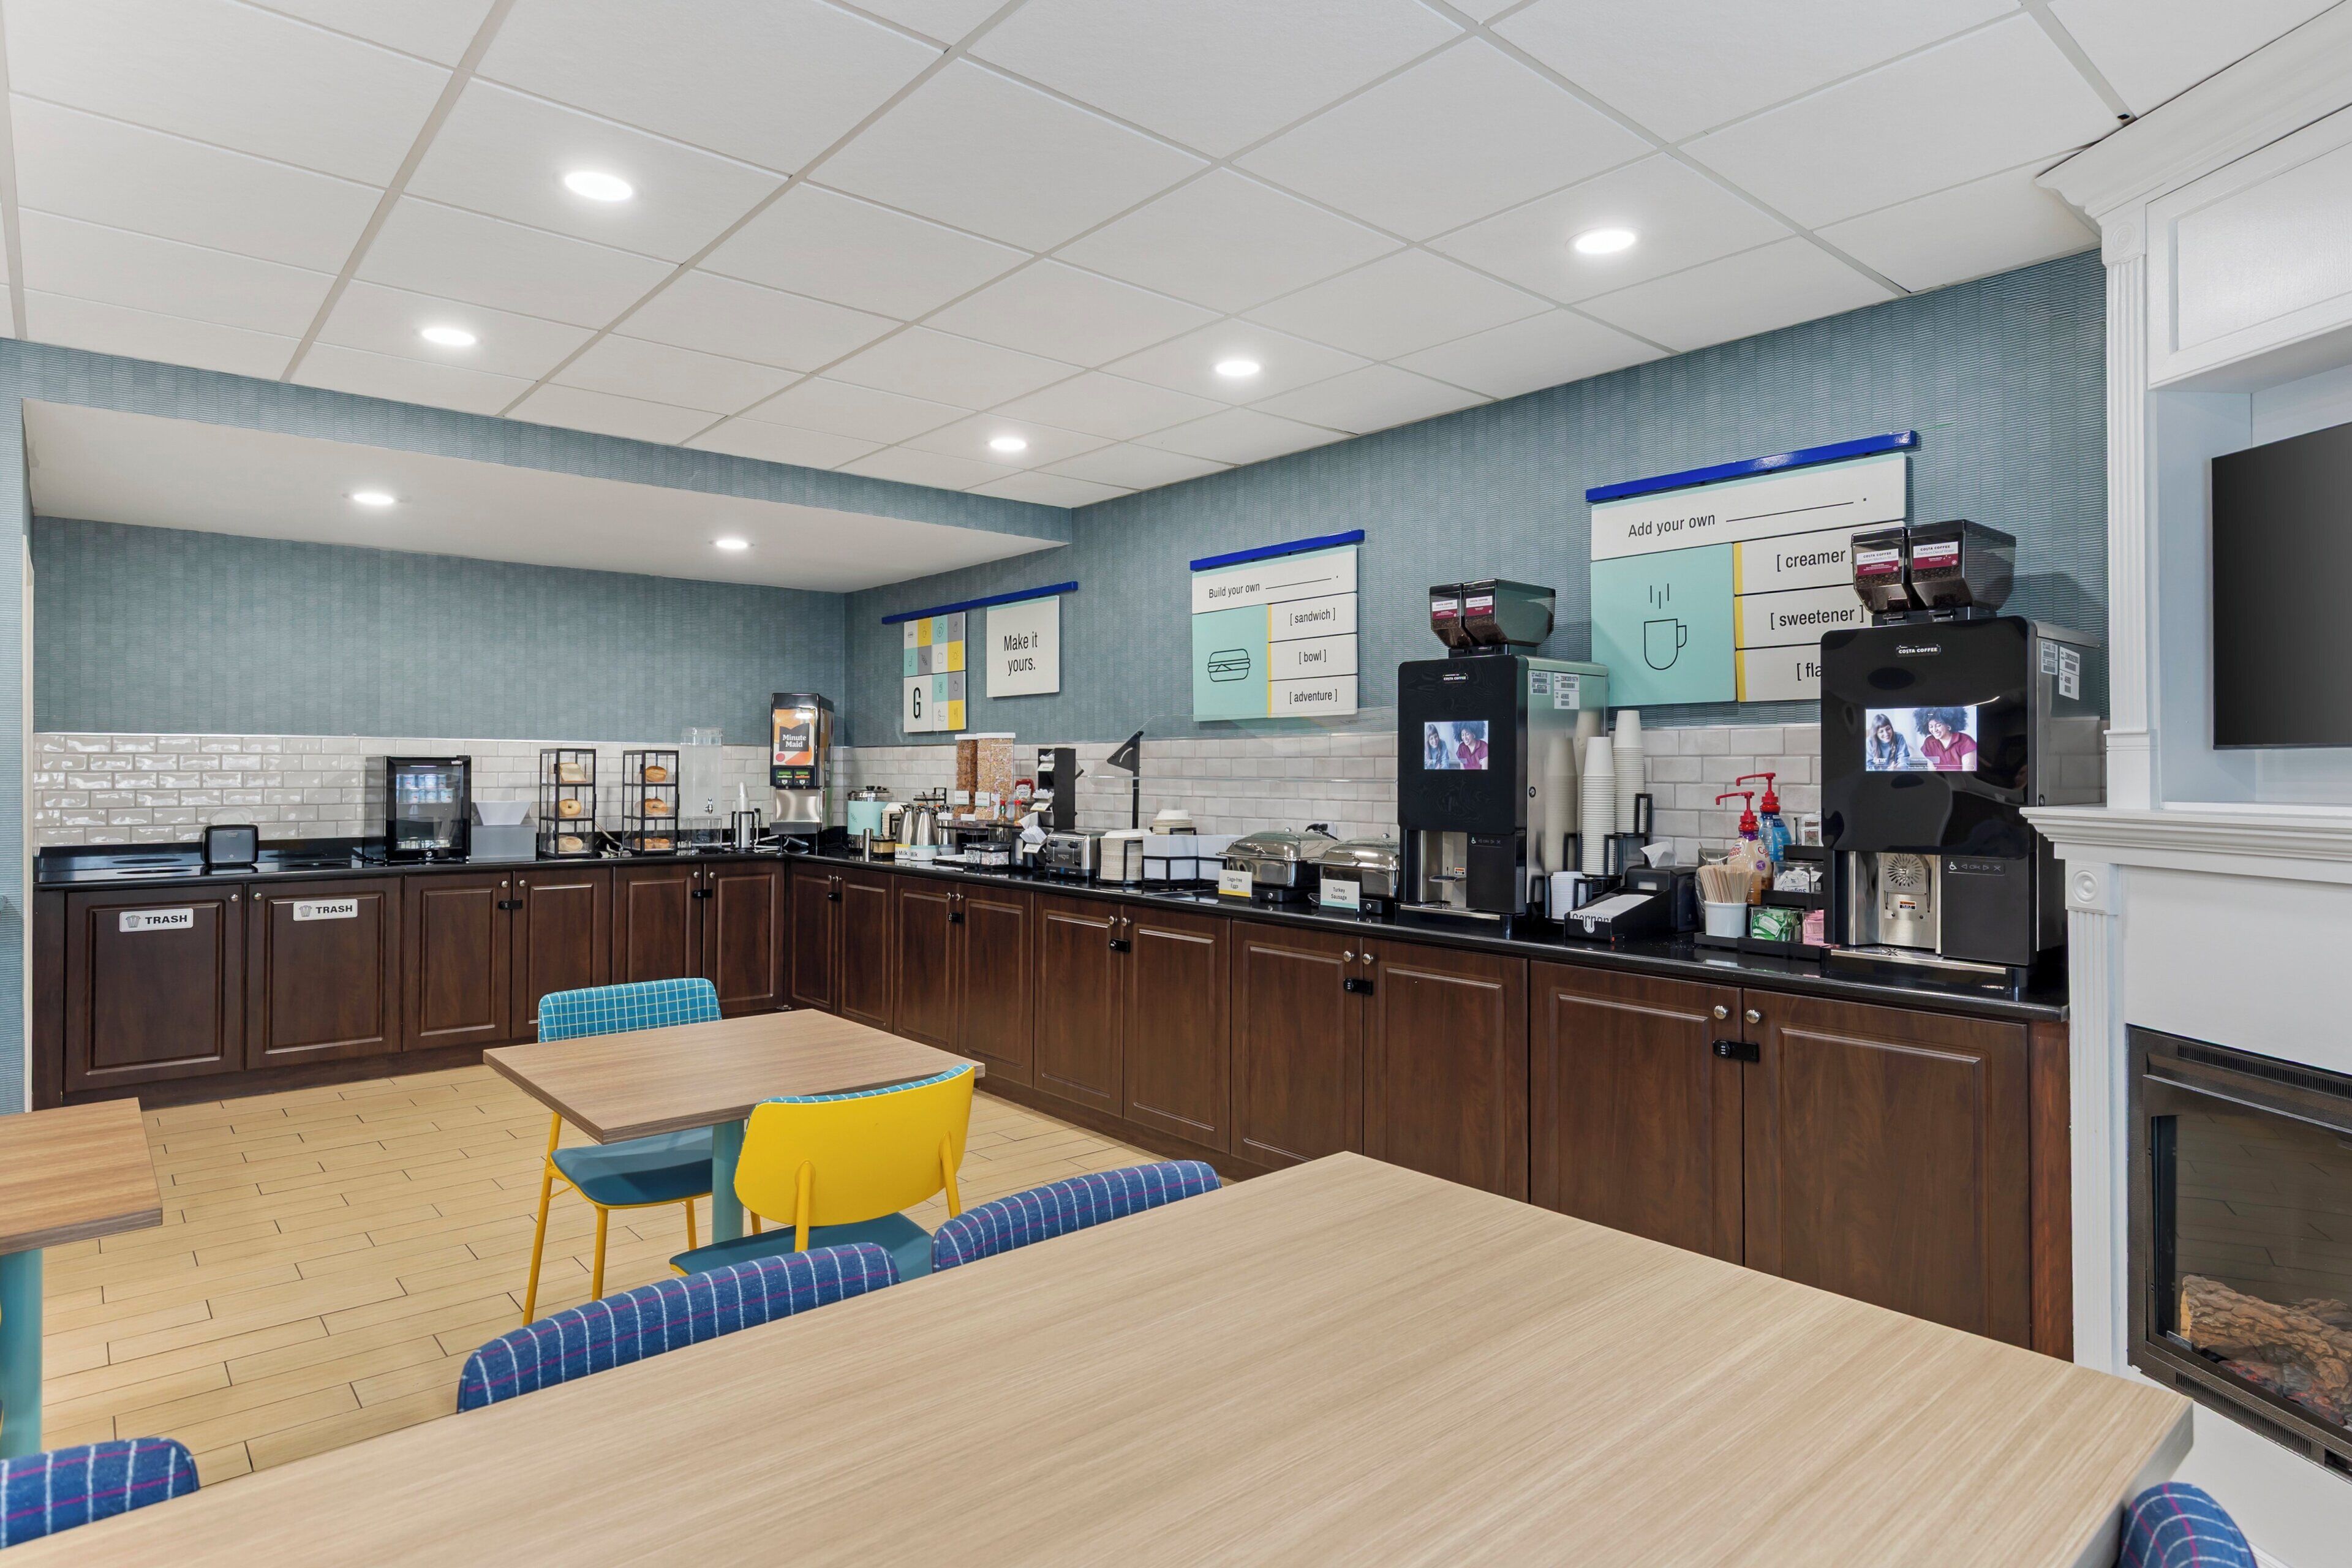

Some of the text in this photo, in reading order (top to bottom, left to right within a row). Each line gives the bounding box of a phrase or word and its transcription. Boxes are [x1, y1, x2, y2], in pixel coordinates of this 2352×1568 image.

[1628, 514, 1715, 538] Add your own
[1208, 583, 1260, 598] Build your own
[1004, 631, 1038, 651] Make it
[1008, 657, 1036, 676] yours.
[913, 687, 921, 719] G
[315, 905, 353, 914] TRASH
[145, 914, 187, 925] TRASH
